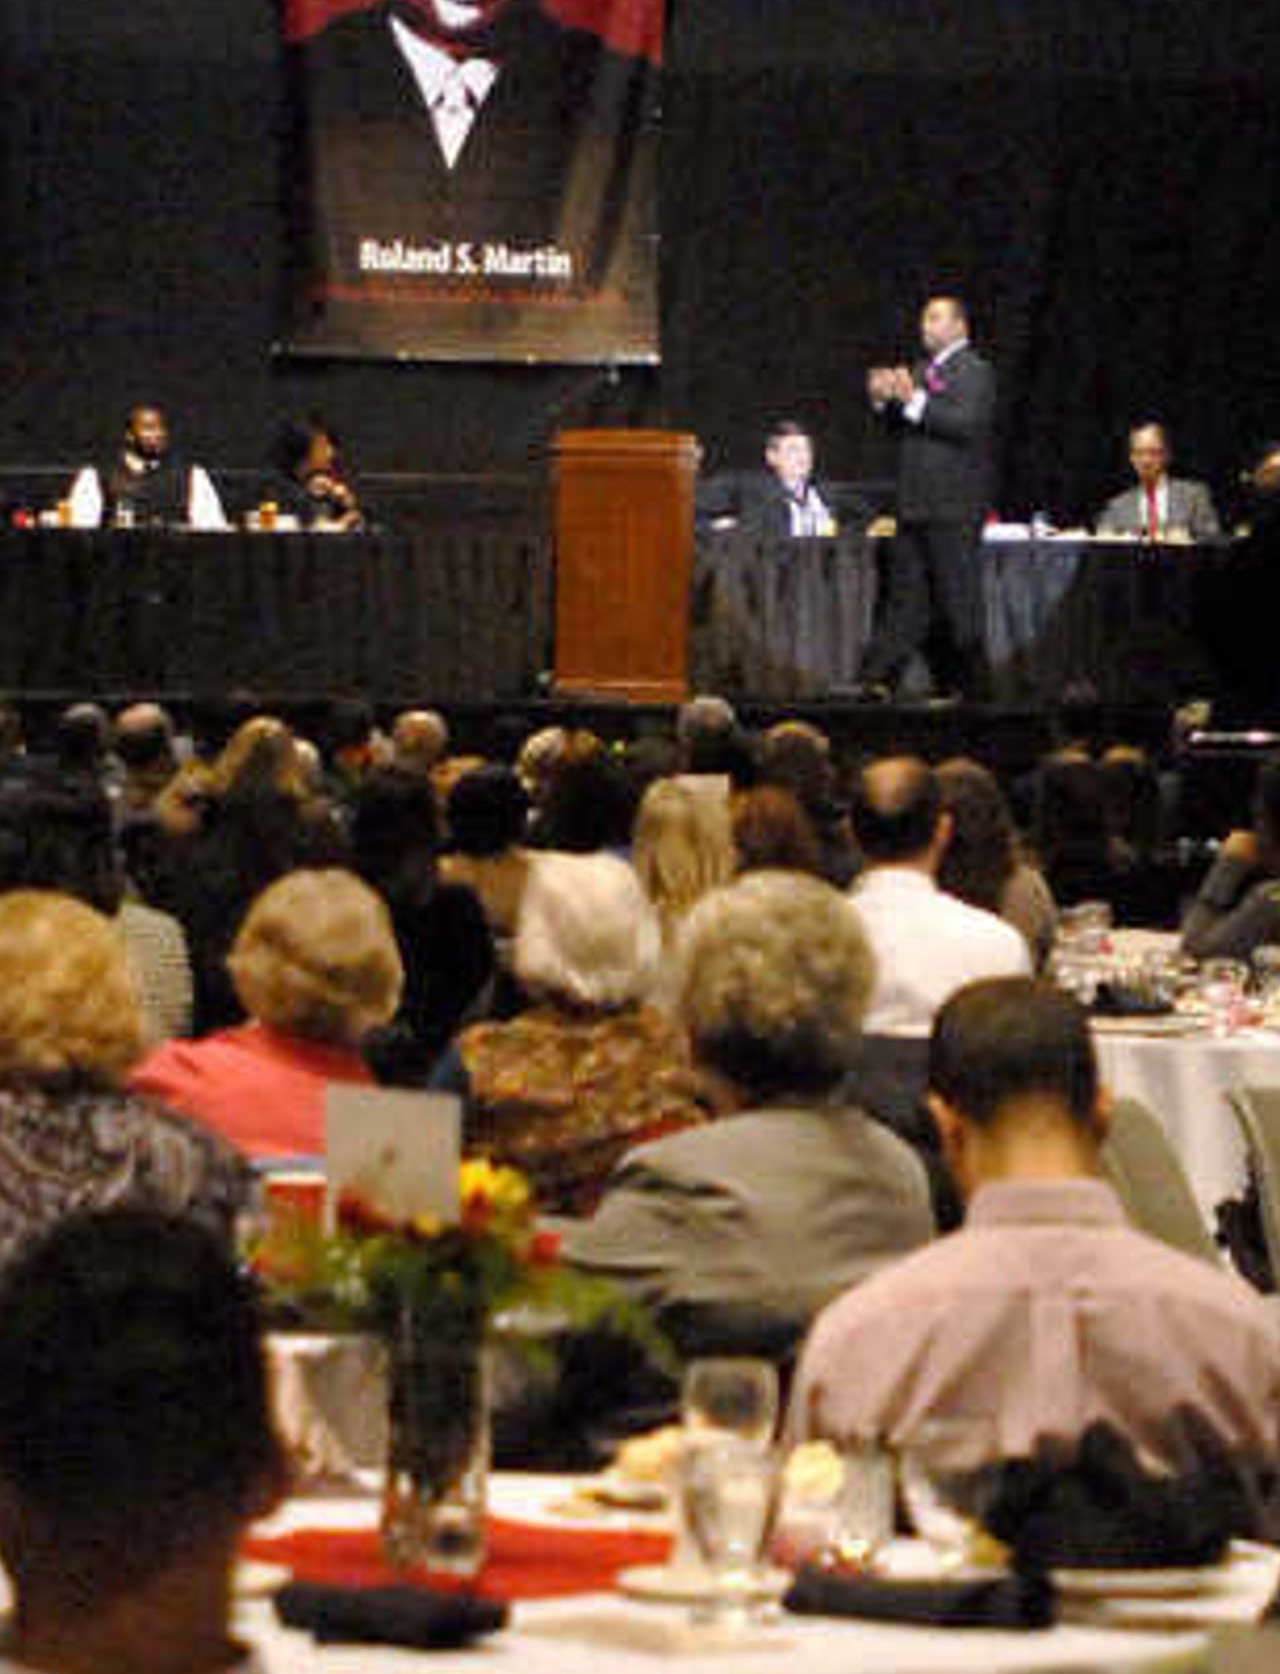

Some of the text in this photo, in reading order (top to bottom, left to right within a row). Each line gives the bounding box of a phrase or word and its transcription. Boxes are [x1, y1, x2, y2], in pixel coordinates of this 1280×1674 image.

[358, 238, 572, 277] Roland S. Martin
